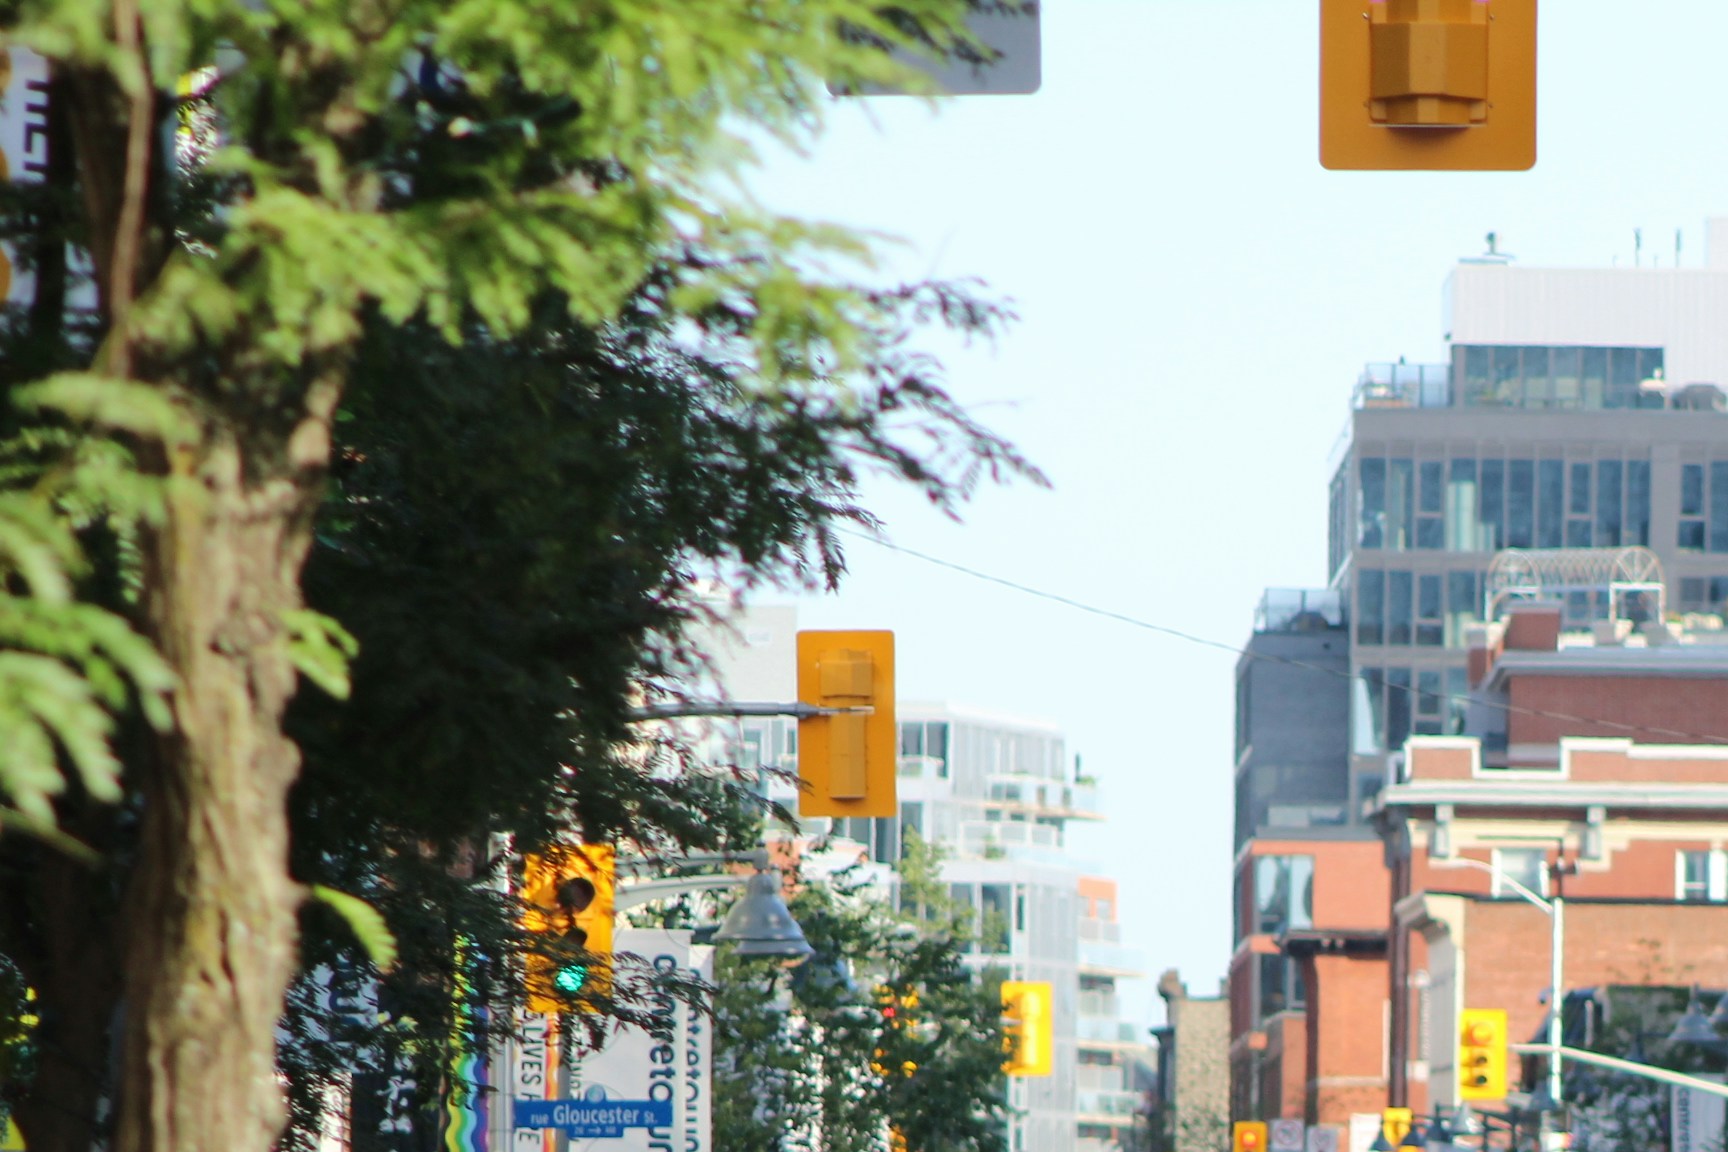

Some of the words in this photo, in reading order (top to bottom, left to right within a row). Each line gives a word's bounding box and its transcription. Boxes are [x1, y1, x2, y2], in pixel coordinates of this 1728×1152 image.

[530, 1112, 549, 1125] rue
[553, 1104, 640, 1125] Gloucester
[644, 1111, 658, 1125] St.
